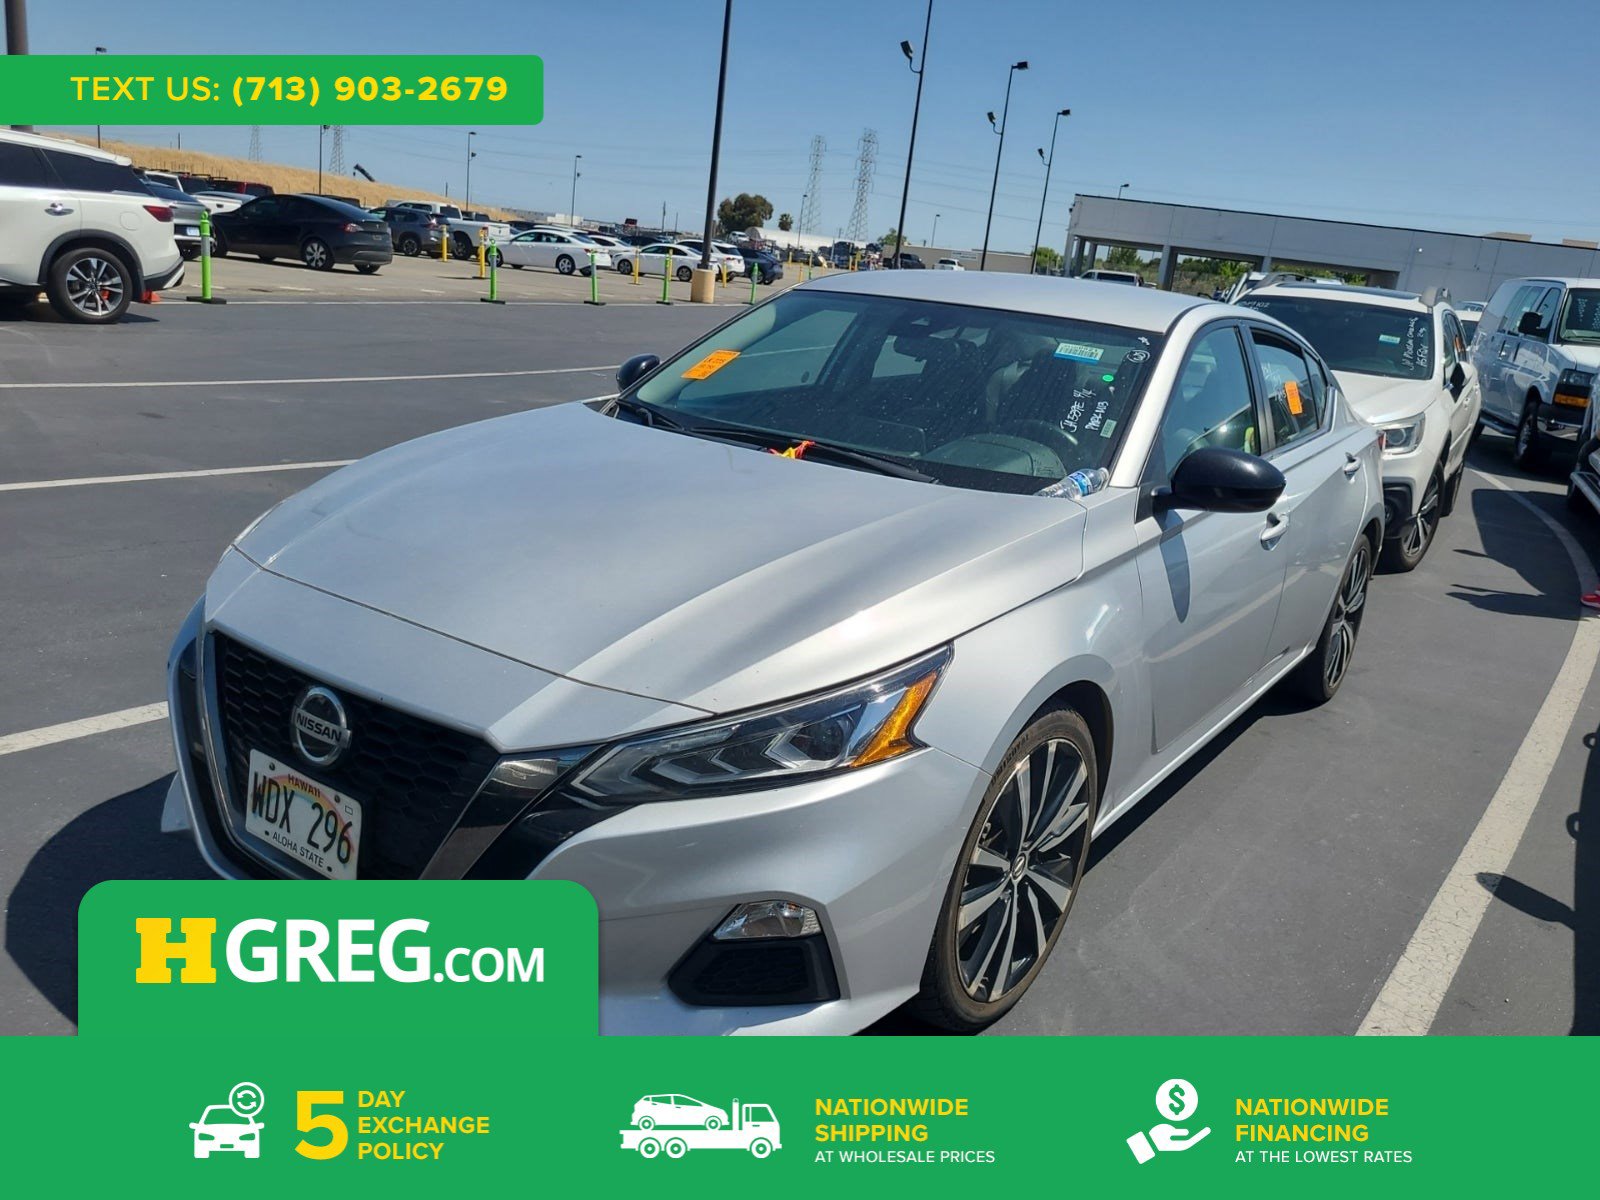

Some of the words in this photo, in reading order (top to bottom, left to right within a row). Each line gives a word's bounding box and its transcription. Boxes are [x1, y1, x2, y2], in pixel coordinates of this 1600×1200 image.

[296, 712, 342, 743] NISSAN
[288, 773, 321, 798] HAWAII
[252, 771, 295, 834] WDX
[307, 802, 353, 864] 296
[272, 831, 298, 853] ALOHA
[300, 846, 325, 868] STATE
